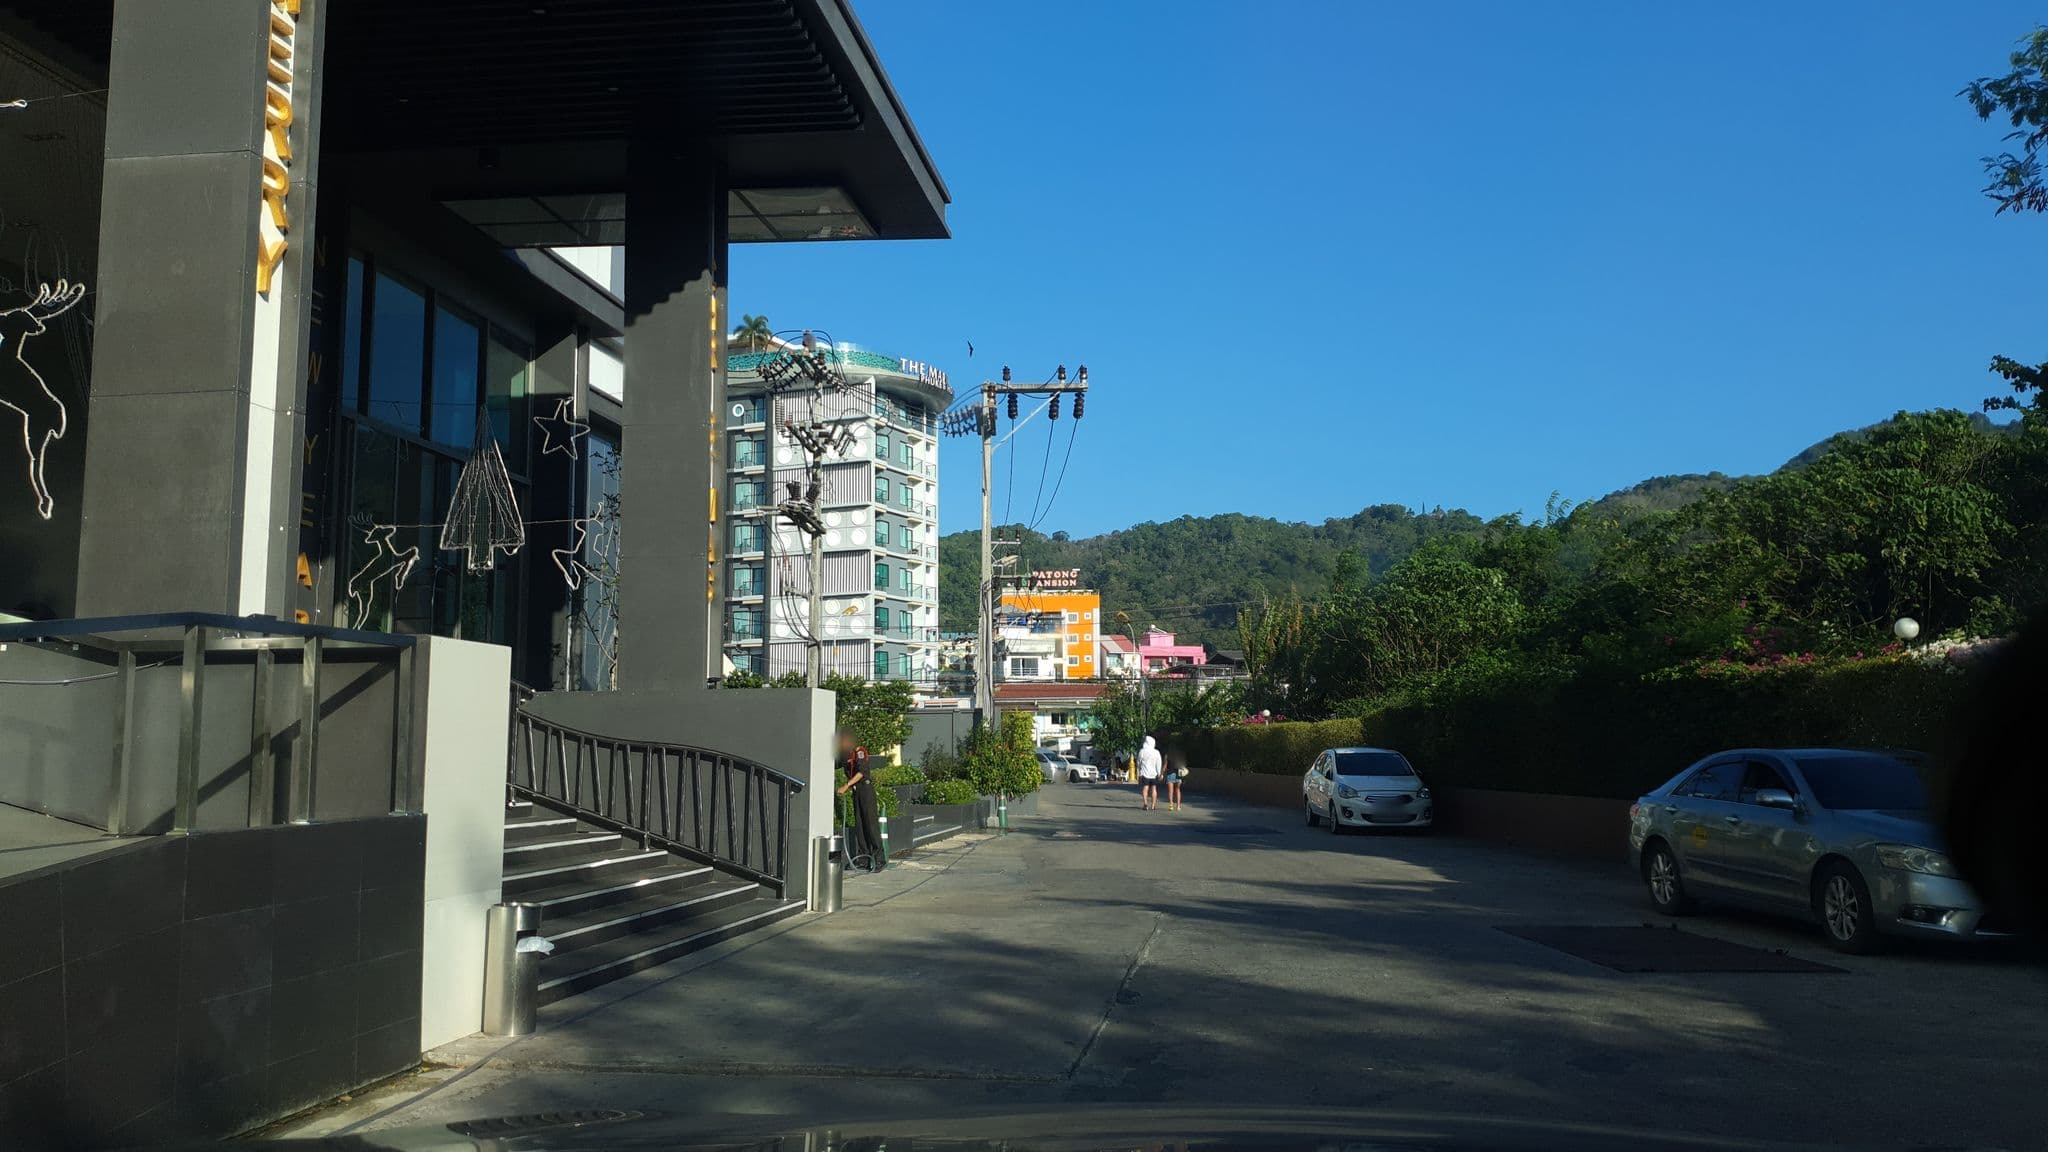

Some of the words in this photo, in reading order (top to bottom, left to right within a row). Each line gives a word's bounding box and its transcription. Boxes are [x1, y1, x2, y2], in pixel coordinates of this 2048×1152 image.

[258, 0, 301, 295] ERRY
[900, 358, 925, 374] THE
[1032, 570, 1077, 578] PATONG
[1028, 579, 1076, 587] ANSION
